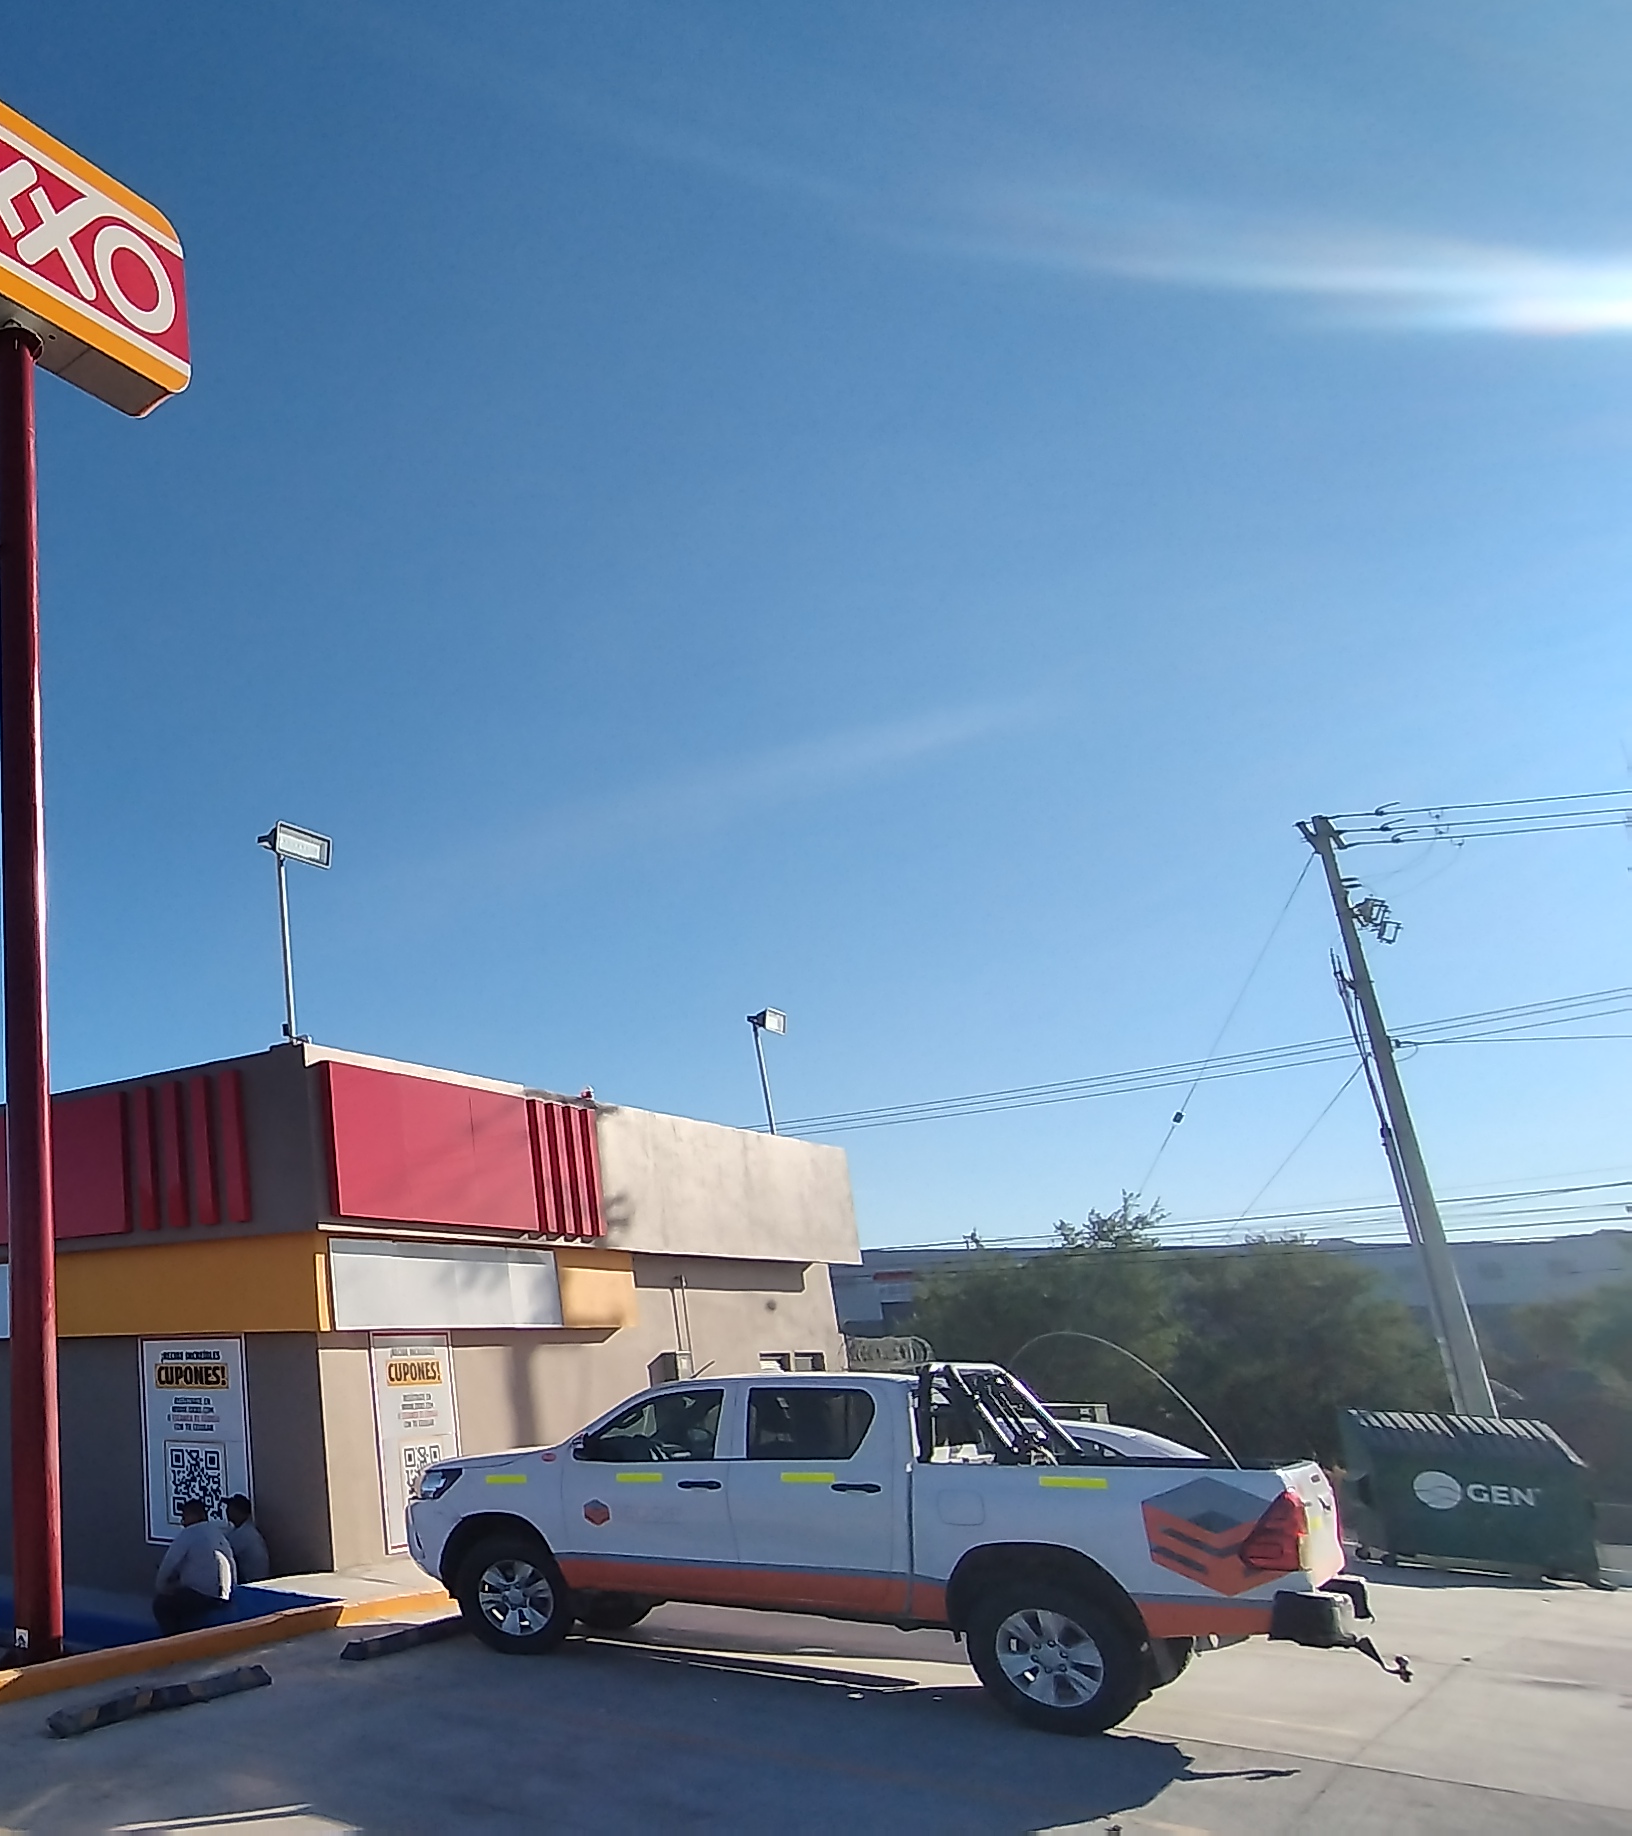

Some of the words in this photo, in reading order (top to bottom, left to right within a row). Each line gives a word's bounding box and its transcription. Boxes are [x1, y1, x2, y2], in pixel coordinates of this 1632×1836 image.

[157, 1365, 227, 1386] CUPONES!
[388, 1361, 442, 1382] CUPONES!
[1466, 1483, 1536, 1507] GEN
